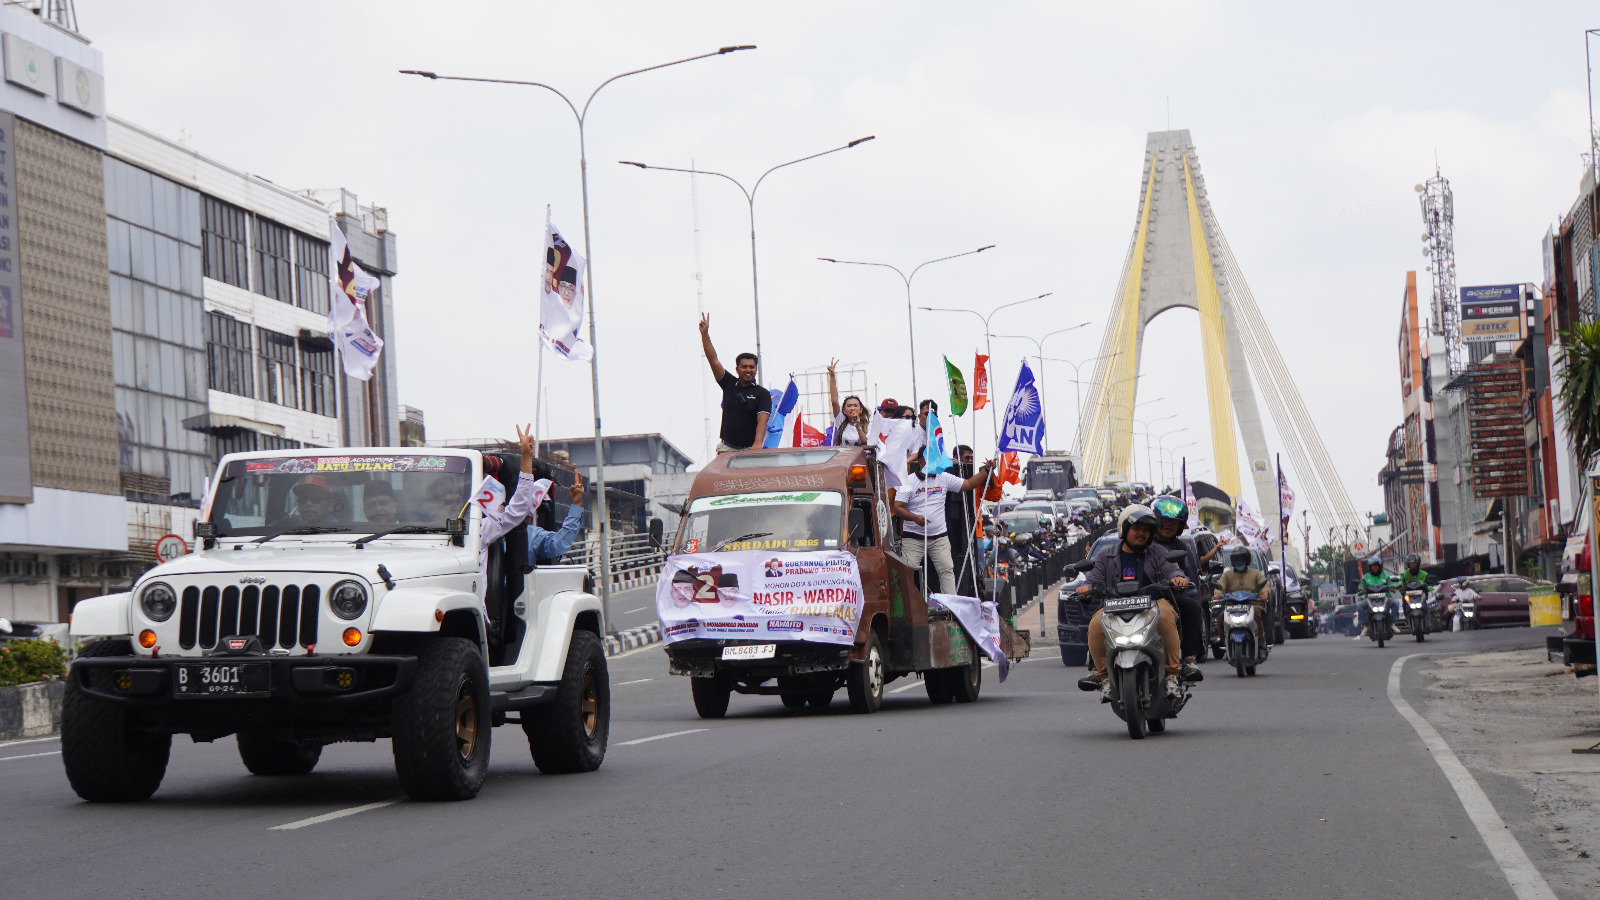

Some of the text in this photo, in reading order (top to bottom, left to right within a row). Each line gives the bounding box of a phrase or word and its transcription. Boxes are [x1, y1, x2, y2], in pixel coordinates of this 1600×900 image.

[316, 462, 393, 471] BATU TILAM
[477, 490, 494, 509] 2
[160, 543, 178, 559] 40
[723, 539, 791, 552] SERDADU
[785, 560, 824, 568] GUBERNUR
[785, 567, 819, 575] PRABOWO
[240, 575, 267, 585] Jeep
[695, 574, 716, 599] 2
[753, 591, 794, 606] NASIR
[803, 588, 857, 605] WARDAN
[790, 606, 824, 617] RIAU
[825, 605, 857, 622] EMAS
[179, 666, 239, 684] B 3601
